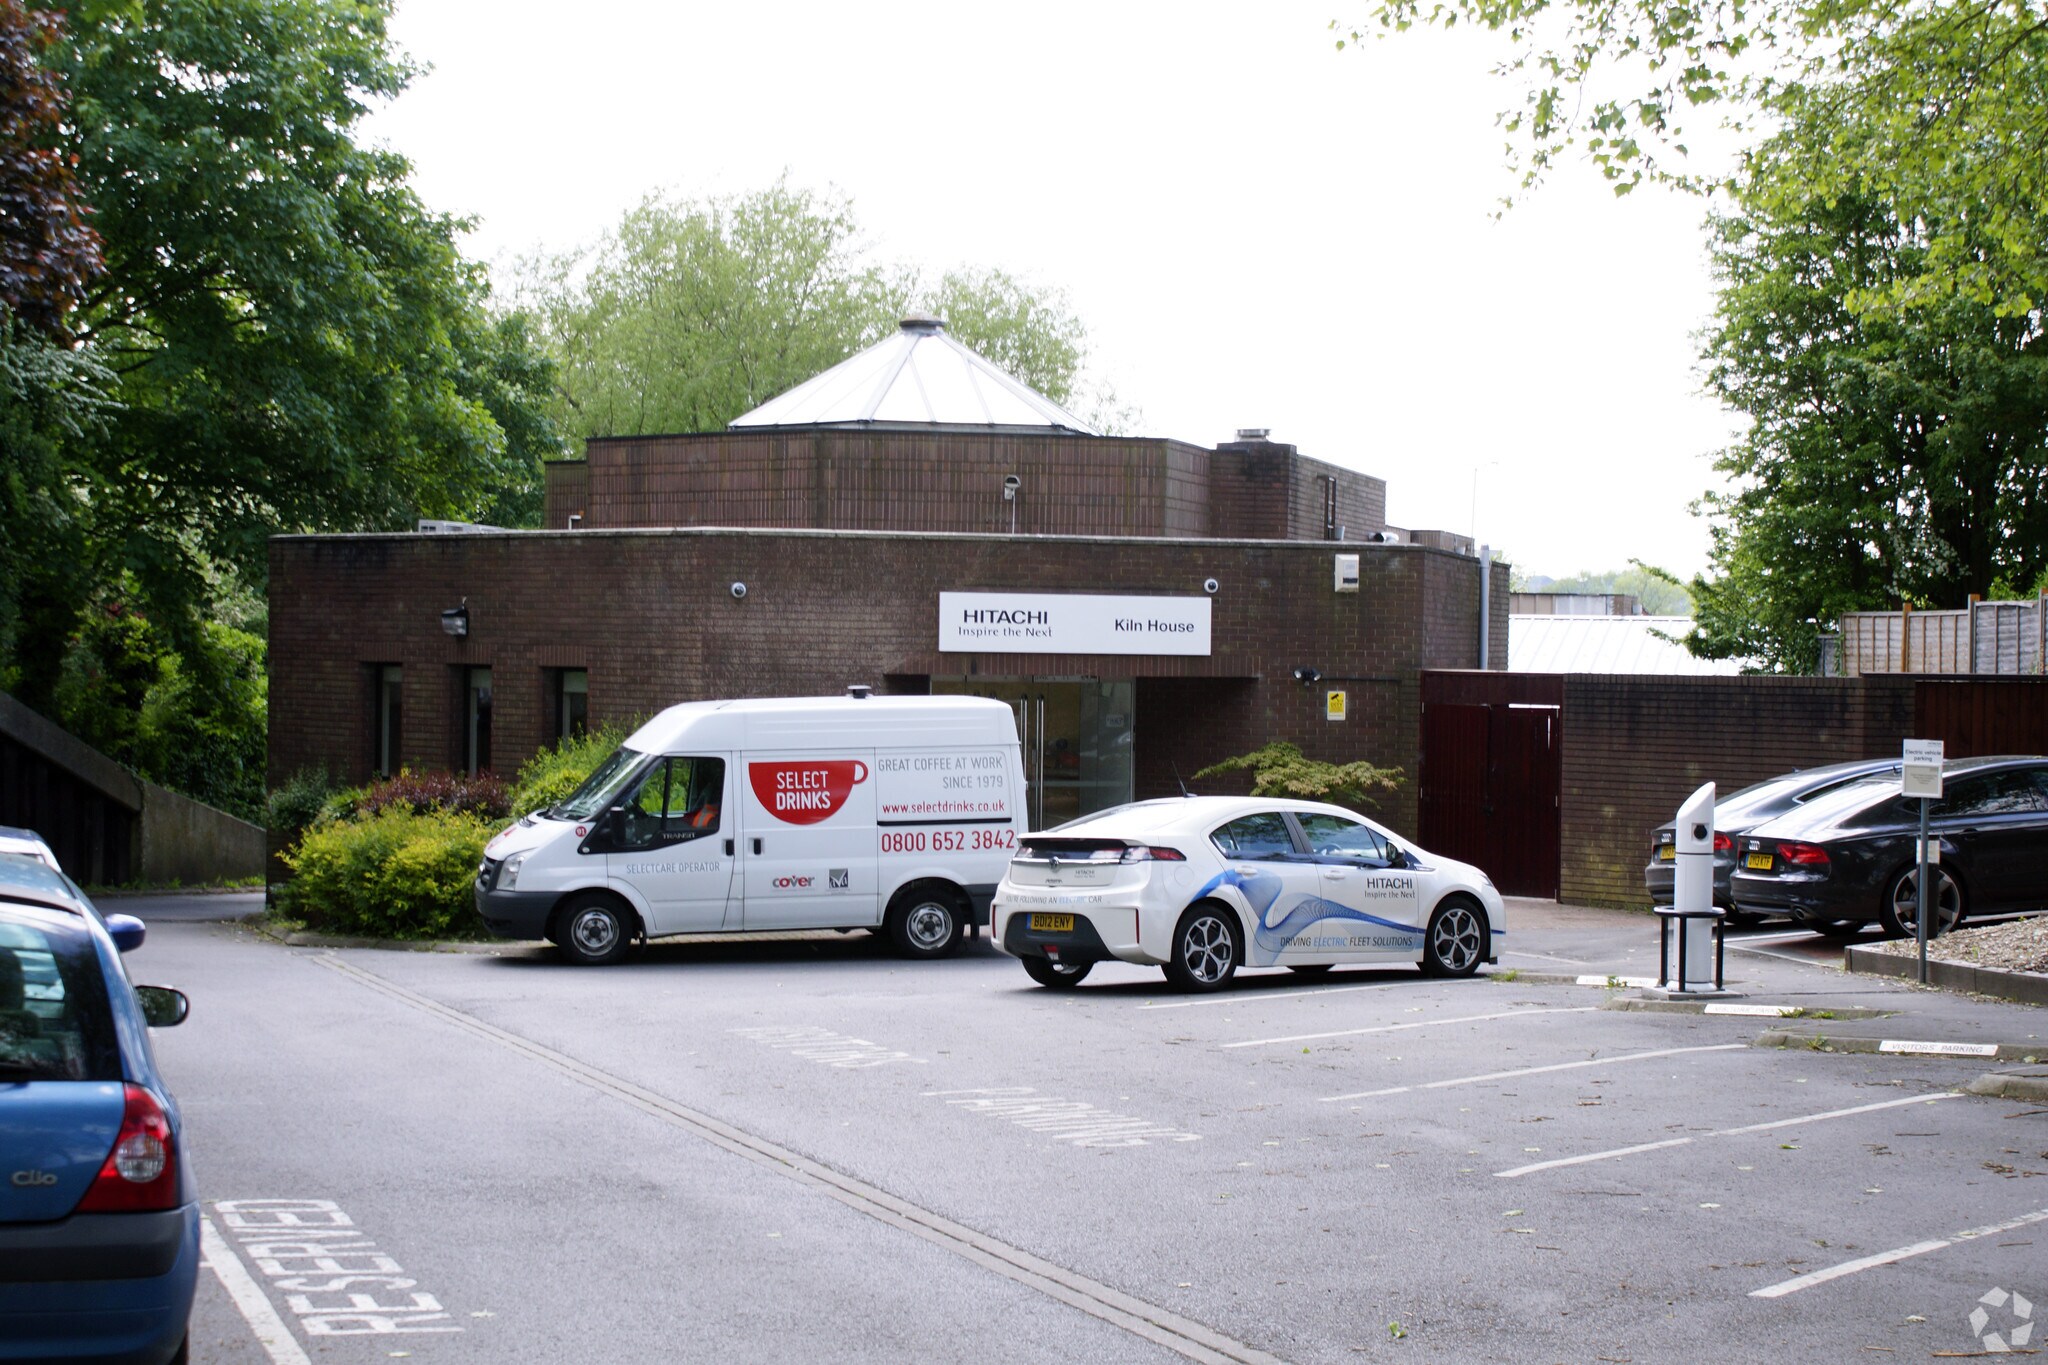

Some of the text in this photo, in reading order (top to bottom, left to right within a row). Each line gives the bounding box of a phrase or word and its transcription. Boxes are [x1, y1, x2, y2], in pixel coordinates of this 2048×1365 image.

[963, 609, 1049, 625] HITACHI
[957, 626, 1053, 638] Inspire the Next
[1114, 618, 1196, 633] Kiln House
[878, 756, 1003, 772] GREAT COFFEE AT WORK
[776, 771, 829, 790] SELECT
[942, 775, 1004, 789] SINCE 1979
[776, 791, 831, 811] DRINKS
[882, 800, 1005, 815] www.selectdrinks.co.uk
[662, 832, 696, 840] TRANSIT
[881, 829, 1015, 853] 0800 652 3842
[626, 861, 720, 874] SELECTCARE OPERATOR
[772, 874, 815, 888] cover
[1366, 877, 1413, 890] HITACHI
[1048, 896, 1057, 904] AN
[1088, 895, 1103, 904] CAR
[1364, 890, 1416, 900] Inspire the Next
[1054, 914, 1071, 928] ENY
[1280, 936, 1413, 947] DRIVING ELECTRIC FLEET SOLUTIONS
[1941, 1045, 1984, 1053] PARKING
[11, 1169, 58, 1187] Clio
[213, 1199, 466, 1336] RESERVED
